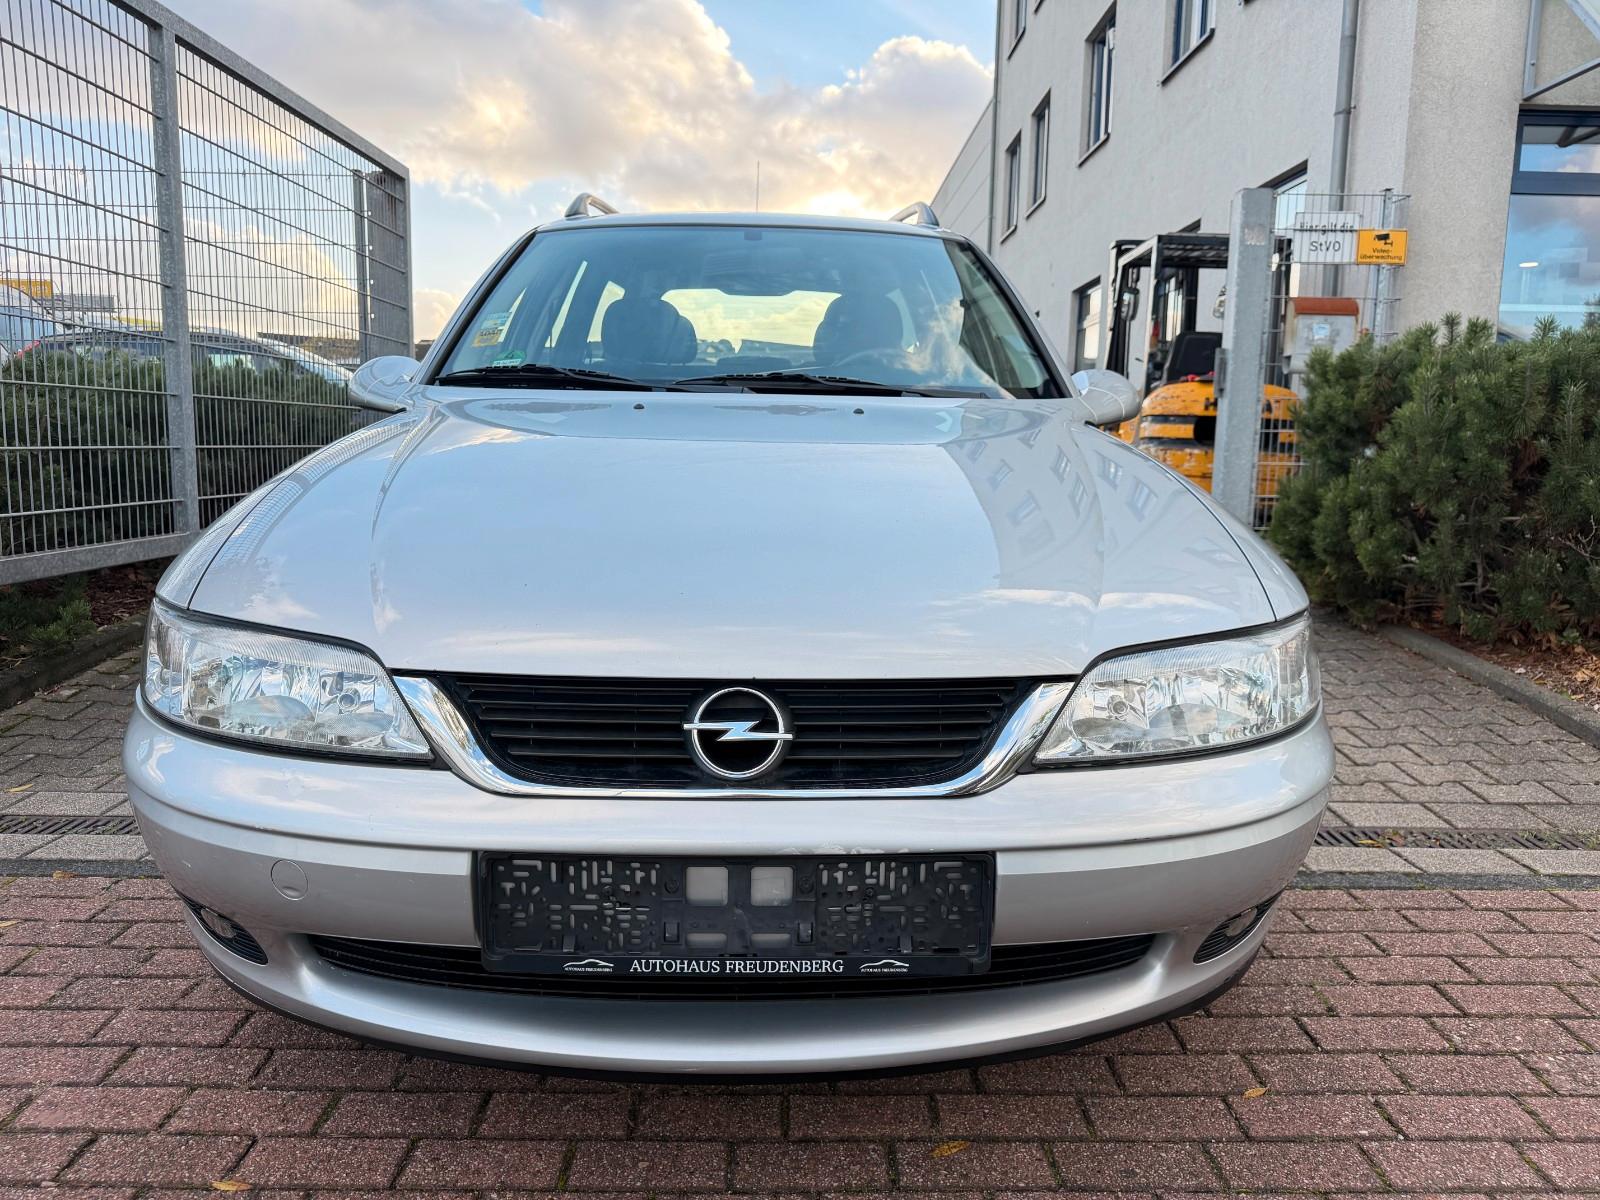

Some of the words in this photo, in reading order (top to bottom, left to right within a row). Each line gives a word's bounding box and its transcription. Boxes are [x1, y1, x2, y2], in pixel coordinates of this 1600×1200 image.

[1309, 240, 1341, 252] StVO
[630, 959, 720, 973] AUTOHAUS
[725, 960, 844, 973] FREUDENBERG
